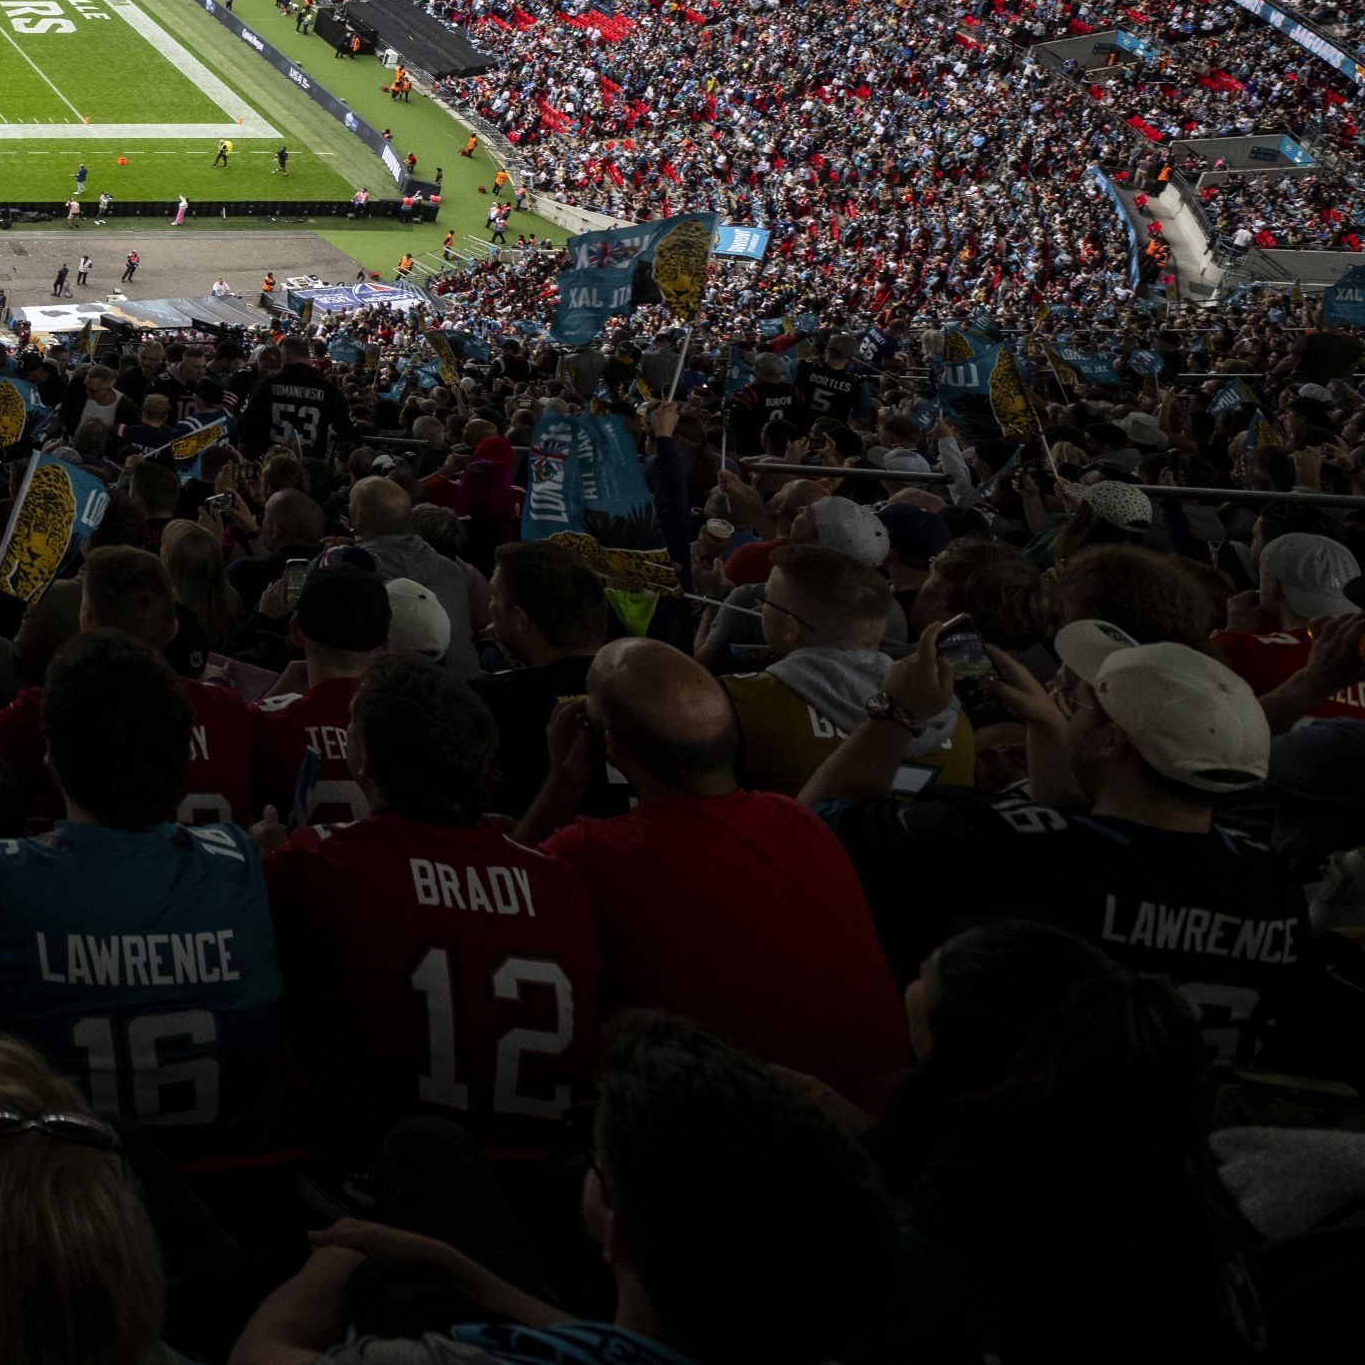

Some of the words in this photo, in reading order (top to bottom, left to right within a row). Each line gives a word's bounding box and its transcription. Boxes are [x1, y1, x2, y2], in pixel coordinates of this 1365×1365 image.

[810, 373, 853, 394] BORTLES
[811, 391, 831, 412] 5
[271, 403, 322, 449] 53
[409, 856, 537, 917] BRADY
[36, 929, 240, 987] LAWRENCE
[1101, 893, 1300, 965] LAWRENCE
[411, 946, 576, 1122] 12
[72, 1010, 220, 1127] 16
